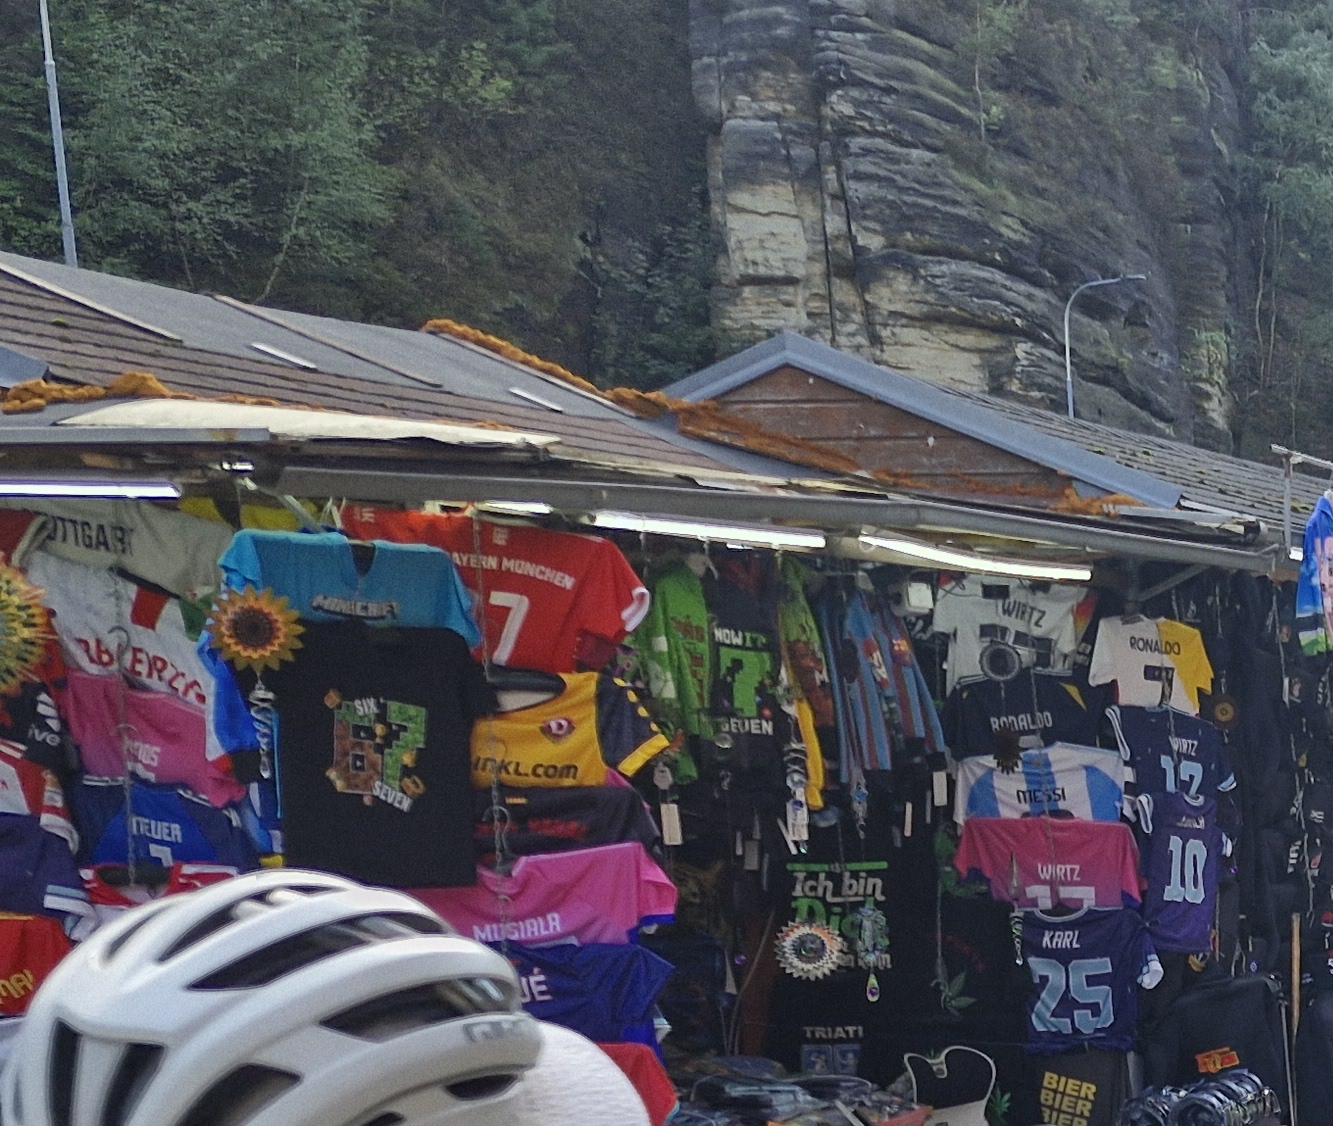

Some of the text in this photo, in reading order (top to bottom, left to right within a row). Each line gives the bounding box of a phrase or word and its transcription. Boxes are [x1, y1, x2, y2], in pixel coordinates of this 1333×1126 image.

[489, 591, 529, 666] 7
[1002, 599, 1046, 629] WIRTZ
[714, 627, 743, 646] NOW
[1129, 636, 1181, 656] RONALDO
[354, 698, 379, 716] SIX
[990, 711, 1053, 733] RONALDO
[372, 781, 414, 812] SEVEN
[1016, 786, 1067, 804] MESSI
[1038, 863, 1081, 881] WIRTZ
[1163, 835, 1207, 904] 10
[792, 871, 886, 901] Ich bin
[472, 913, 562, 942] MUSIALA
[1042, 930, 1081, 949] KARL
[1028, 957, 1115, 1035] 25
[1043, 1071, 1097, 1100] BIER
[1041, 1088, 1092, 1117] BIER
